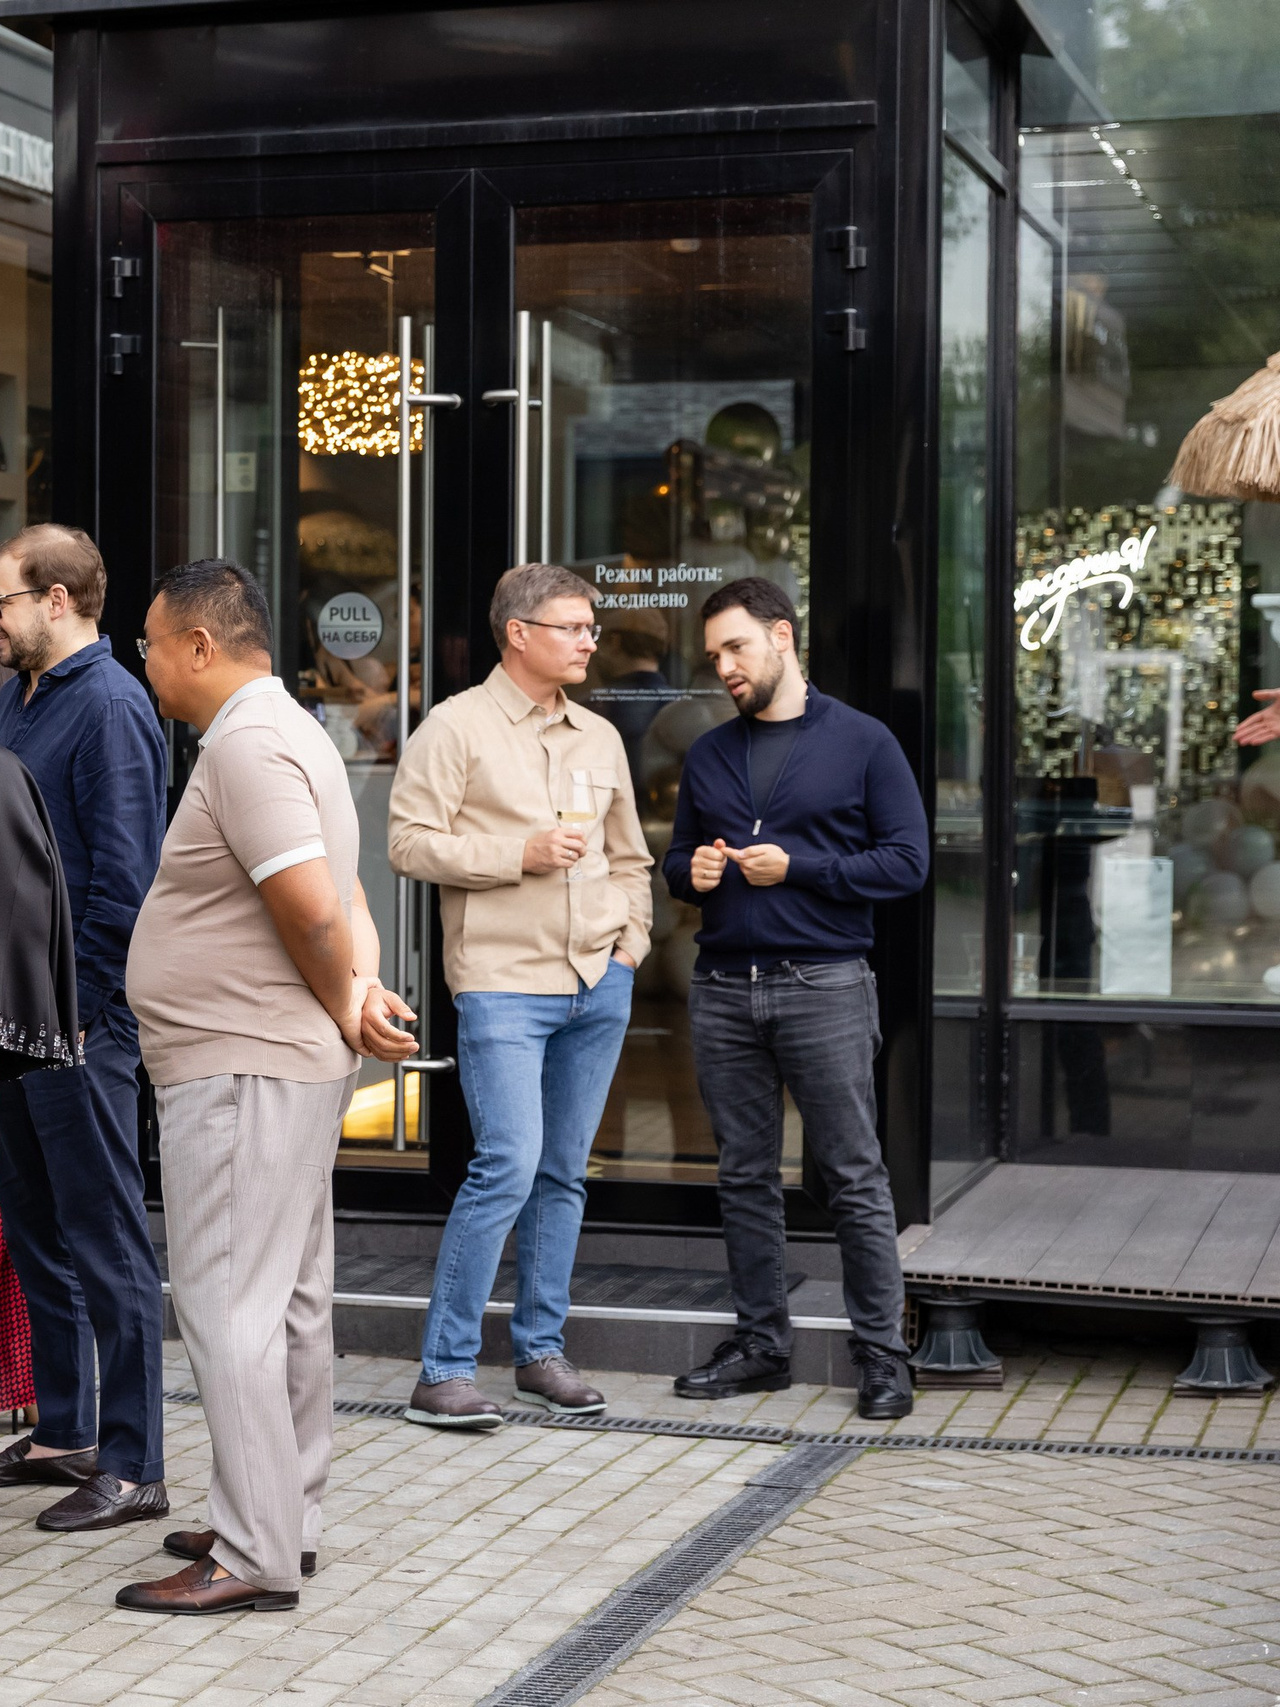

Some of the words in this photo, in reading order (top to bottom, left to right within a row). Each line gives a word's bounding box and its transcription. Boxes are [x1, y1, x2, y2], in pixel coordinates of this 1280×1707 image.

[595, 564, 652, 583] Режим
[657, 562, 723, 587] работы:
[595, 592, 688, 610] ежедневно
[329, 606, 371, 621] PULL
[322, 631, 340, 643] НА
[344, 630, 378, 643] СЕБЯ
